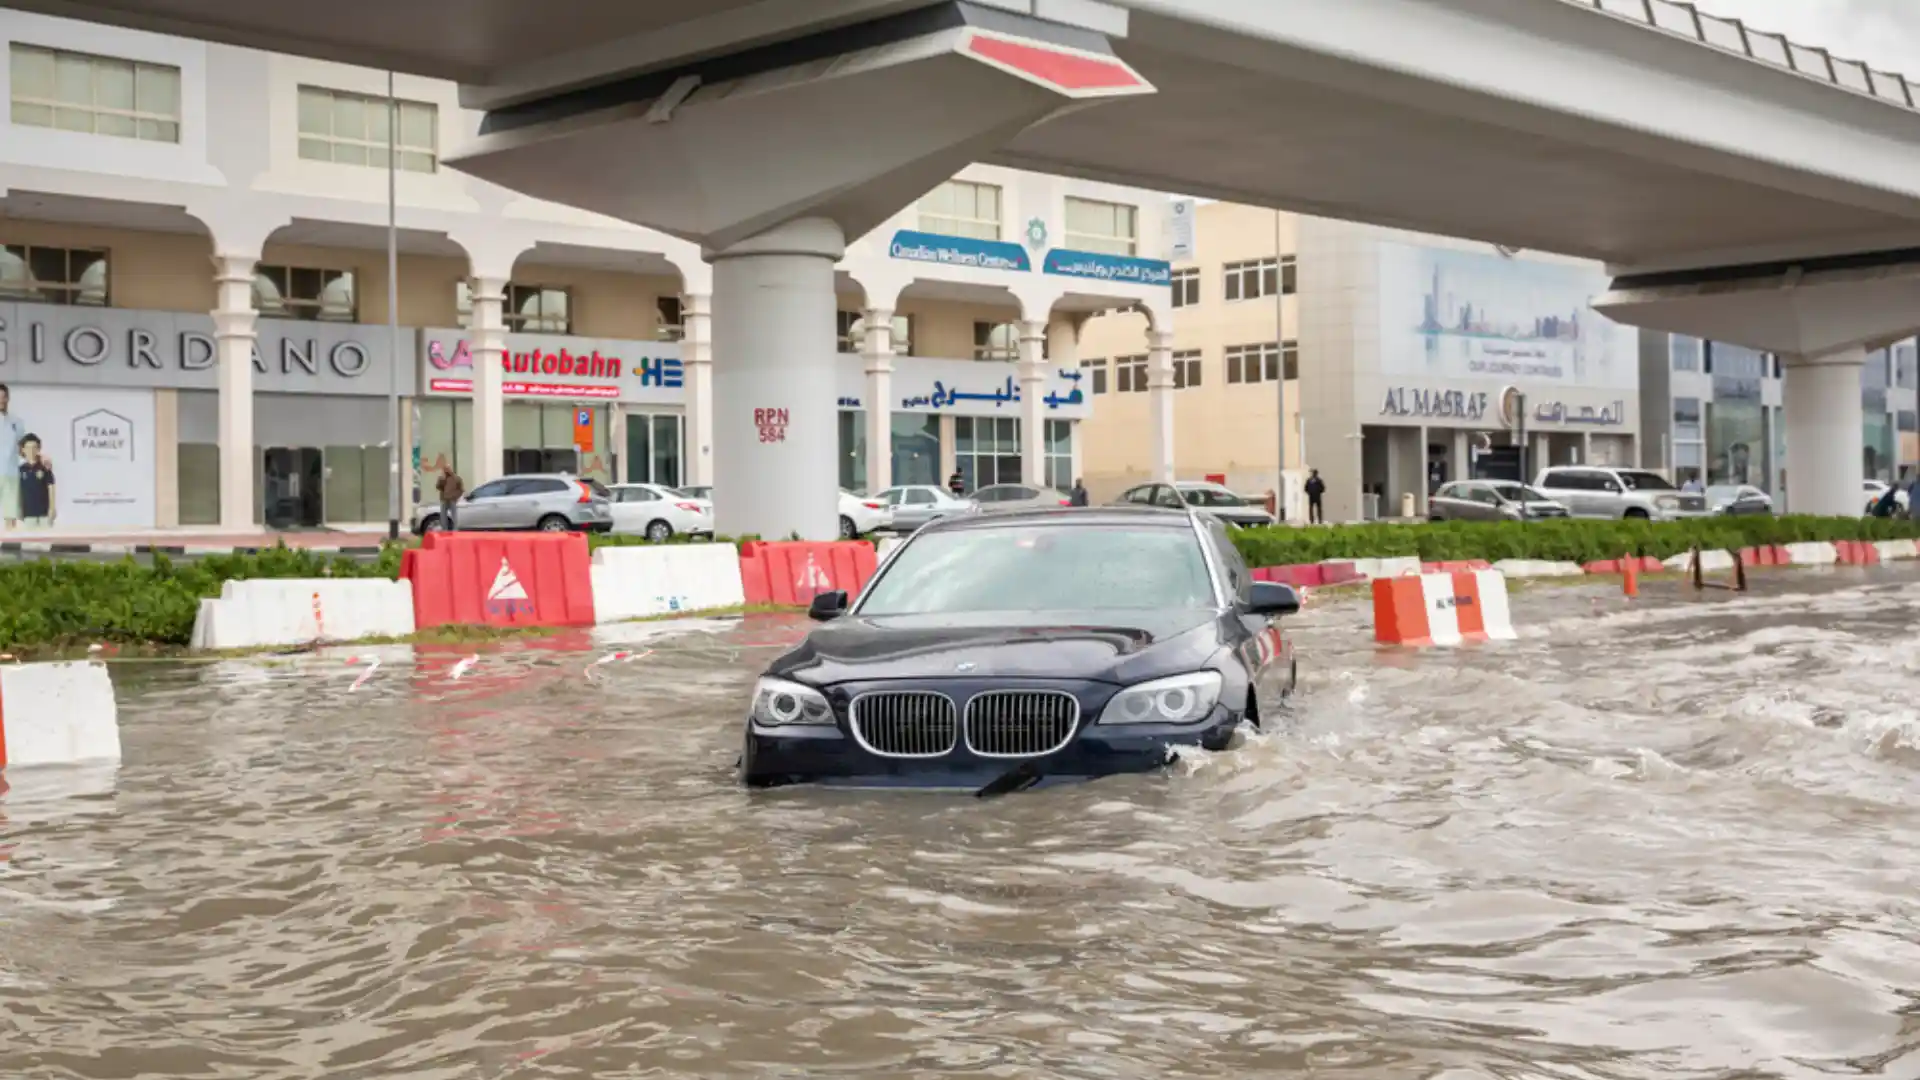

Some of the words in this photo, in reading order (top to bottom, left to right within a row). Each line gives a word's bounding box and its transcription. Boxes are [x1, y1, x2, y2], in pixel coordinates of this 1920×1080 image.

[0, 317, 370, 377] IORDANO
[501, 347, 622, 378] Autobahn
[1379, 386, 1410, 416] AL
[1411, 388, 1488, 420] MASRAF
[754, 407, 789, 425] RPN
[86, 425, 119, 436] TEAM
[759, 426, 785, 443] 584
[81, 438, 124, 449] FAMILY
